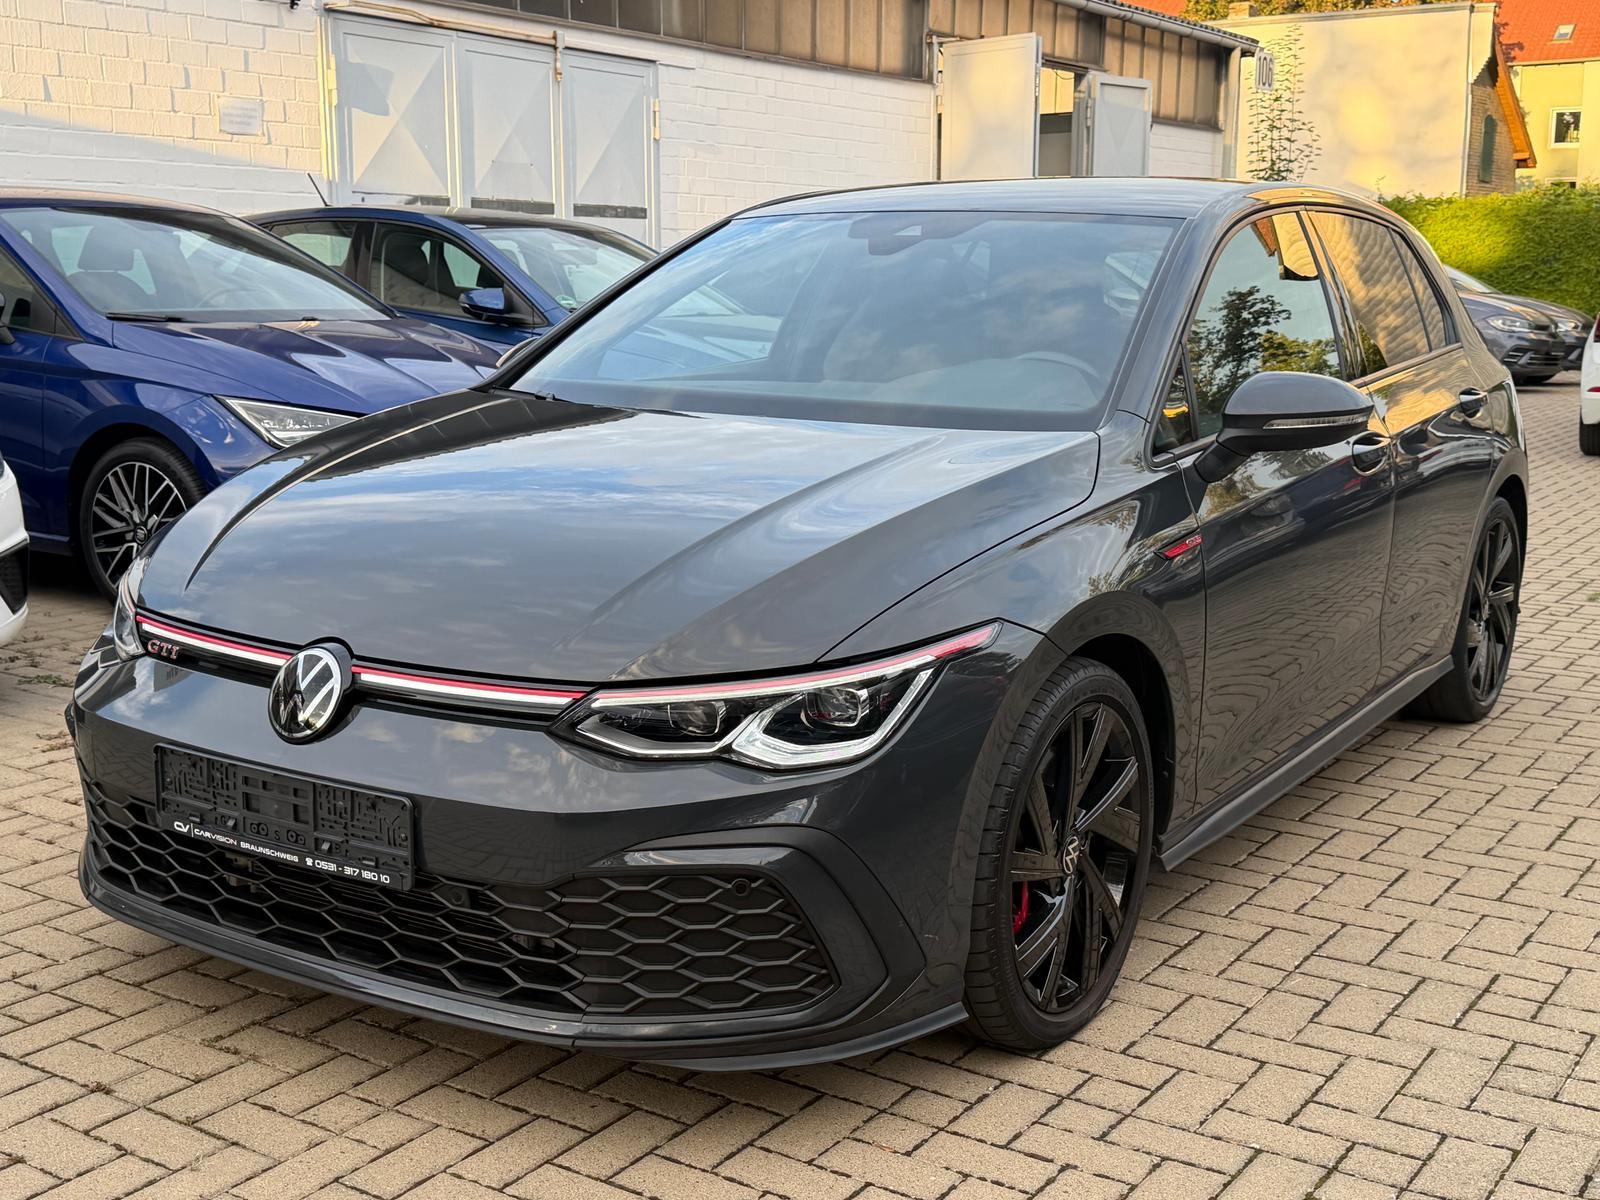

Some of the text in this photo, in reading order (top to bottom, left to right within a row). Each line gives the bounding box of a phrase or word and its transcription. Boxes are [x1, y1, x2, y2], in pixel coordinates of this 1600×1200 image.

[1258, 56, 1273, 88] 106
[147, 640, 180, 660] GTI
[194, 829, 237, 846] CARVISION
[240, 842, 299, 862] BRAUNSCHWEIG
[315, 860, 337, 872] 0531
[343, 866, 359, 876] 317
[361, 870, 378, 882] 180
[380, 873, 390, 884] 10
